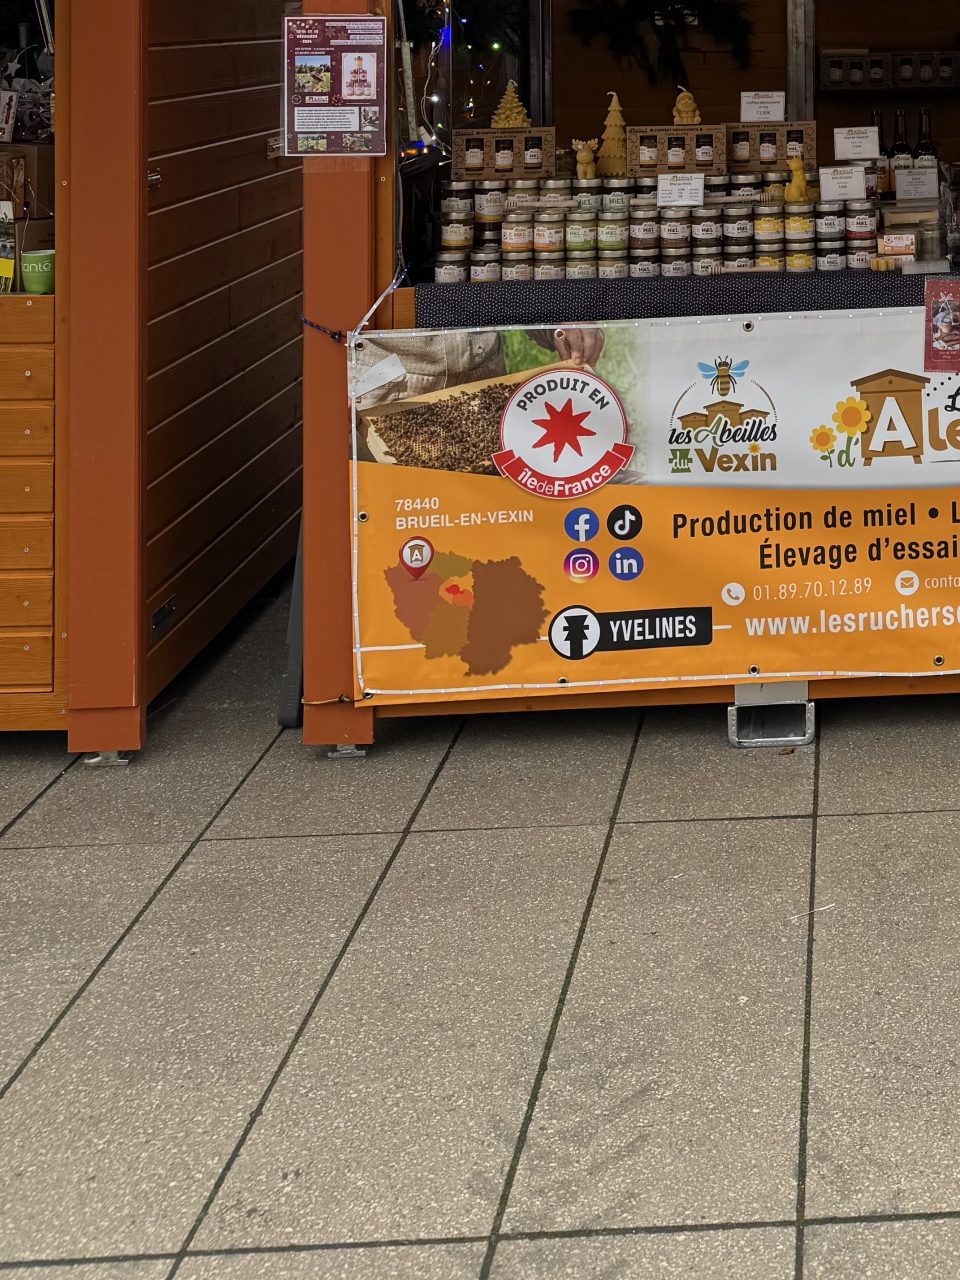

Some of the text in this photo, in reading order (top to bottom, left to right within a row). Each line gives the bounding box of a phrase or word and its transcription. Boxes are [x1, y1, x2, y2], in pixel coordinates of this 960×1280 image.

[23, 260, 51, 272] anté
[516, 377, 611, 412] PRODUIT EN
[668, 414, 778, 448] les Abeilles
[672, 443, 777, 473] du Vexin
[837, 436, 860, 468] d'
[395, 498, 439, 512] 78440
[396, 510, 534, 530] BRUEIL-EN-VEXIN
[673, 507, 812, 539] Production
[823, 506, 852, 529] de
[863, 503, 916, 528] miel
[759, 538, 857, 570] Élevage
[752, 577, 872, 602] 01.89.70.12.89
[608, 614, 696, 642] YVELINES
